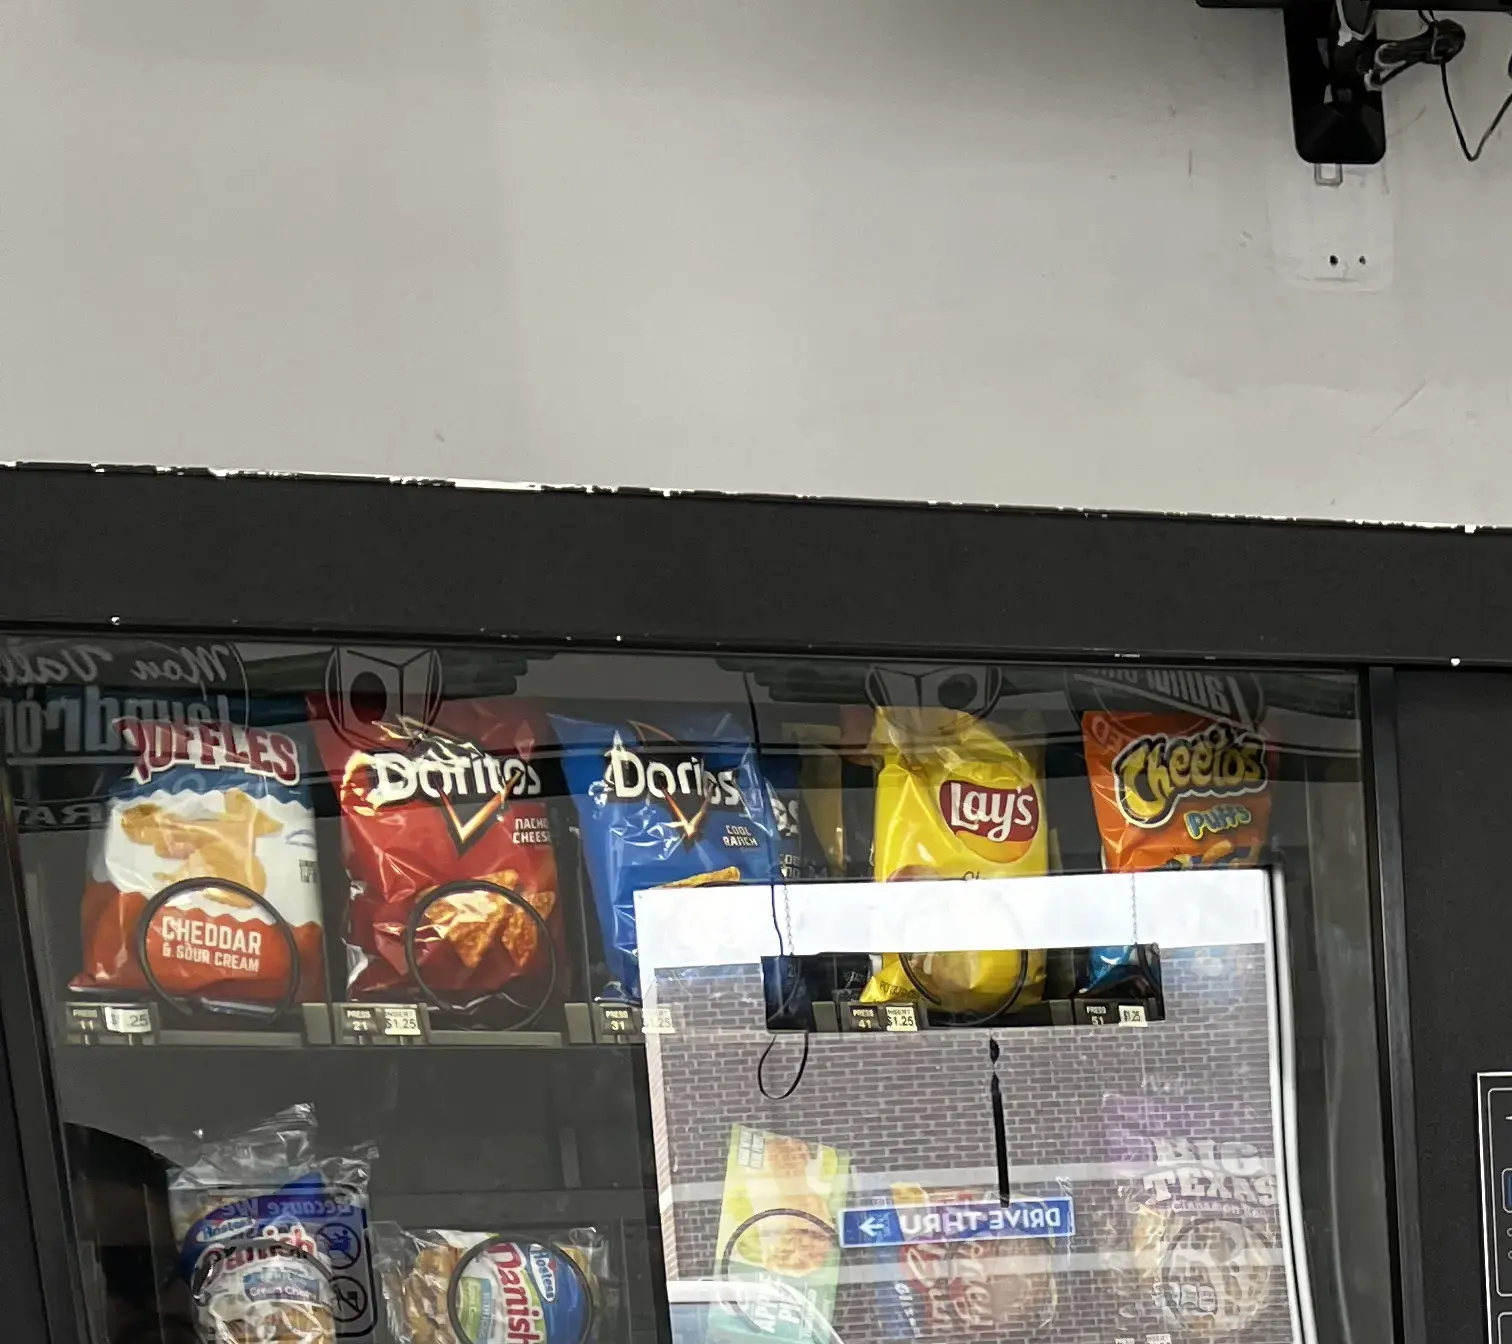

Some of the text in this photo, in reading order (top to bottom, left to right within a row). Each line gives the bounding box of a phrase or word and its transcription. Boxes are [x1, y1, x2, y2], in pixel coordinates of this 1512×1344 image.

[372, 750, 542, 805] Doritos
[1120, 727, 1265, 822] Cheetos
[950, 779, 1035, 842] Lay's
[161, 915, 262, 954] CHEDDAR
[176, 943, 210, 964] SOUR
[213, 950, 260, 973] CREAM
[385, 1017, 417, 1031] $1.25
[888, 1015, 915, 1028] $1.25
[1143, 1167, 1279, 1207] TEXAS
[531, 1245, 554, 1301] Hostess
